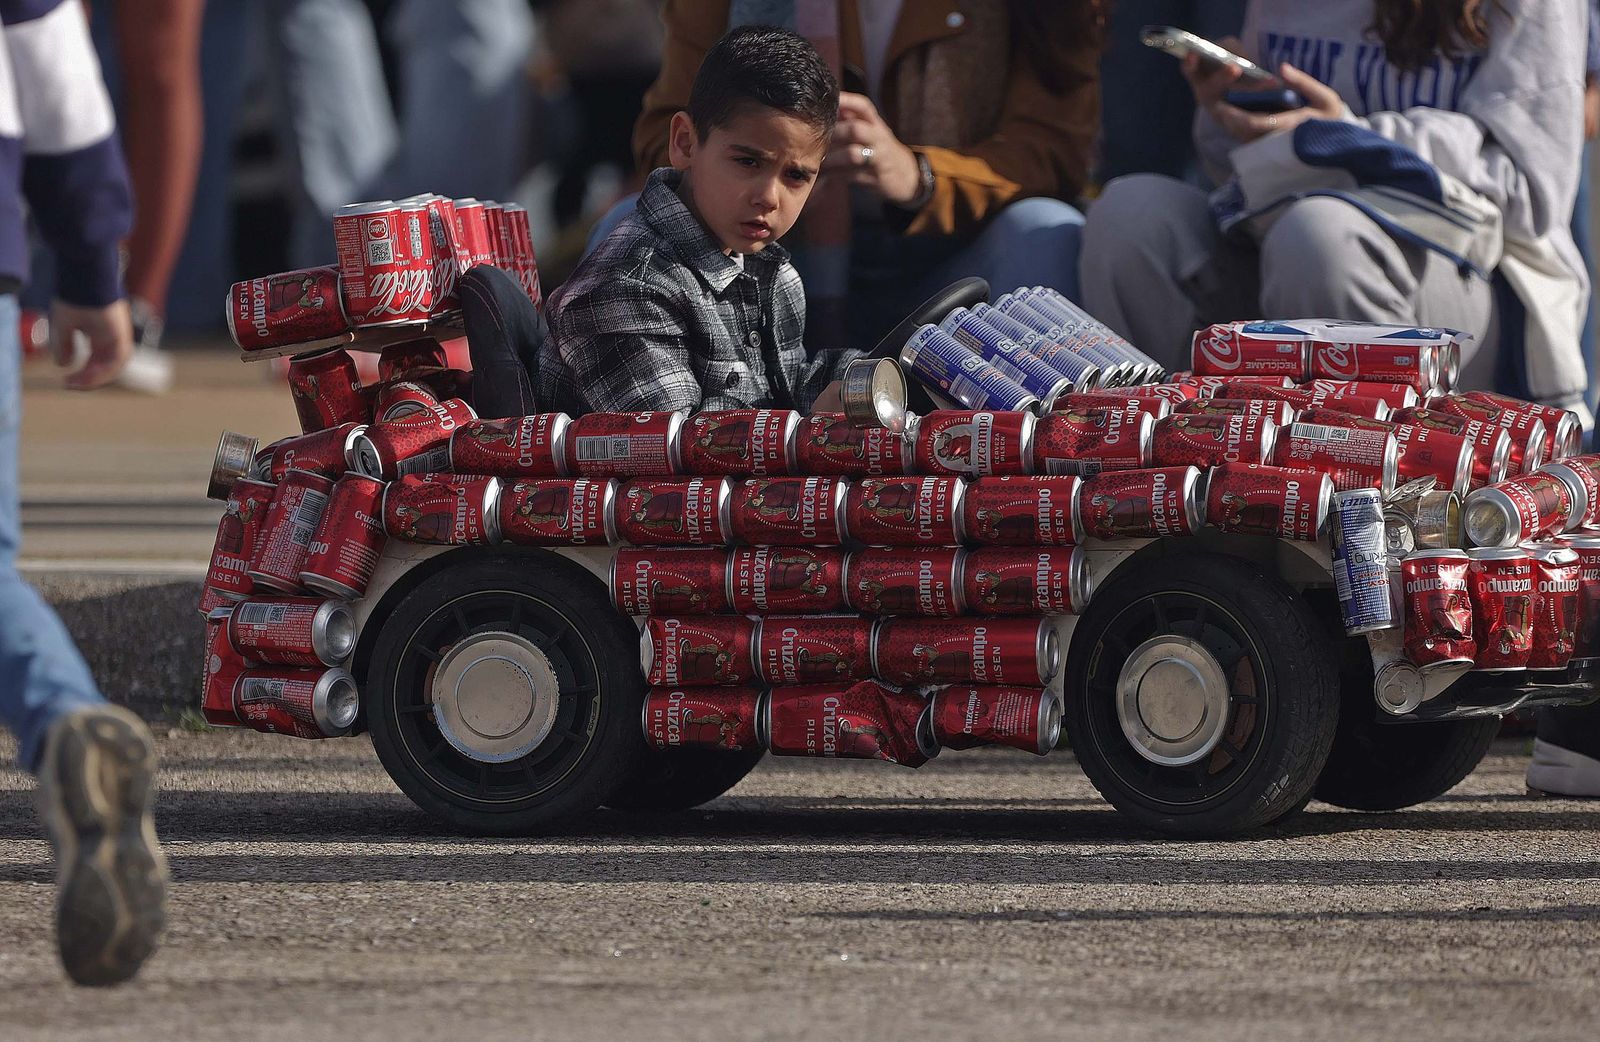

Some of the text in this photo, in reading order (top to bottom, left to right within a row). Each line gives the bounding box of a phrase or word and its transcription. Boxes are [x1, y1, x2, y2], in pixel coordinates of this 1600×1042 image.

[769, 417, 780, 459] PILSEN
[588, 484, 599, 529] PILSEN
[704, 487, 713, 532] PILSEN
[936, 479, 949, 522] PILSEN
[1169, 489, 1182, 532] PILSEN
[740, 552, 750, 596] PILSEN
[654, 639, 662, 686] PILSEN
[963, 689, 978, 734] Cruzcampo
